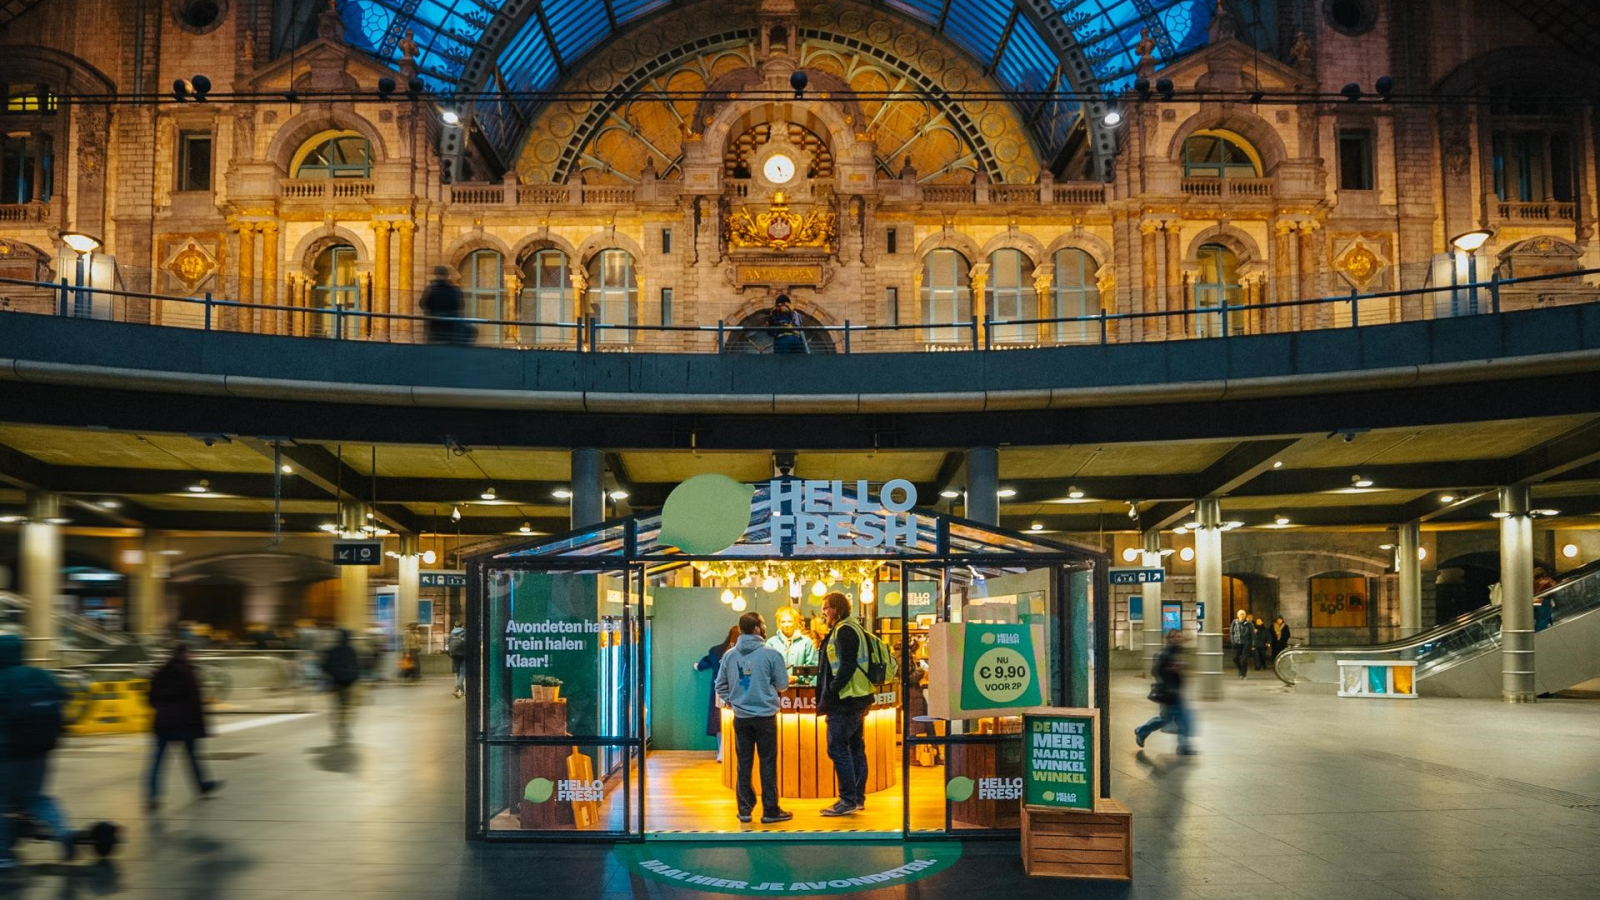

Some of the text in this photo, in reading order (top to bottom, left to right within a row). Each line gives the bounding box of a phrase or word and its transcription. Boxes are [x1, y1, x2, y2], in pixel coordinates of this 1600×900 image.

[745, 269, 814, 279] ANTWERPEN
[770, 479, 918, 512] HELLO
[770, 513, 918, 548] FRESH
[907, 598, 931, 606] RESH
[506, 620, 582, 633] Avondeten
[506, 636, 583, 650] Trein halen
[506, 654, 549, 667] Klaar!
[980, 665, 1026, 681] € 9,90
[985, 682, 1022, 691] VOOR 2P
[1033, 721, 1085, 734] DE NIET
[1033, 733, 1085, 749] MEER
[1033, 748, 1085, 760] NAAR DE
[1032, 759, 1086, 772] WINKEL
[978, 777, 1023, 788] HELLO
[1032, 771, 1086, 784] WINKEL
[557, 779, 604, 791] HELLO
[557, 790, 604, 801] FRESH
[978, 788, 1023, 799] FRESH
[639, 859, 938, 891] HAAL HIER JE AVONDETEN.
